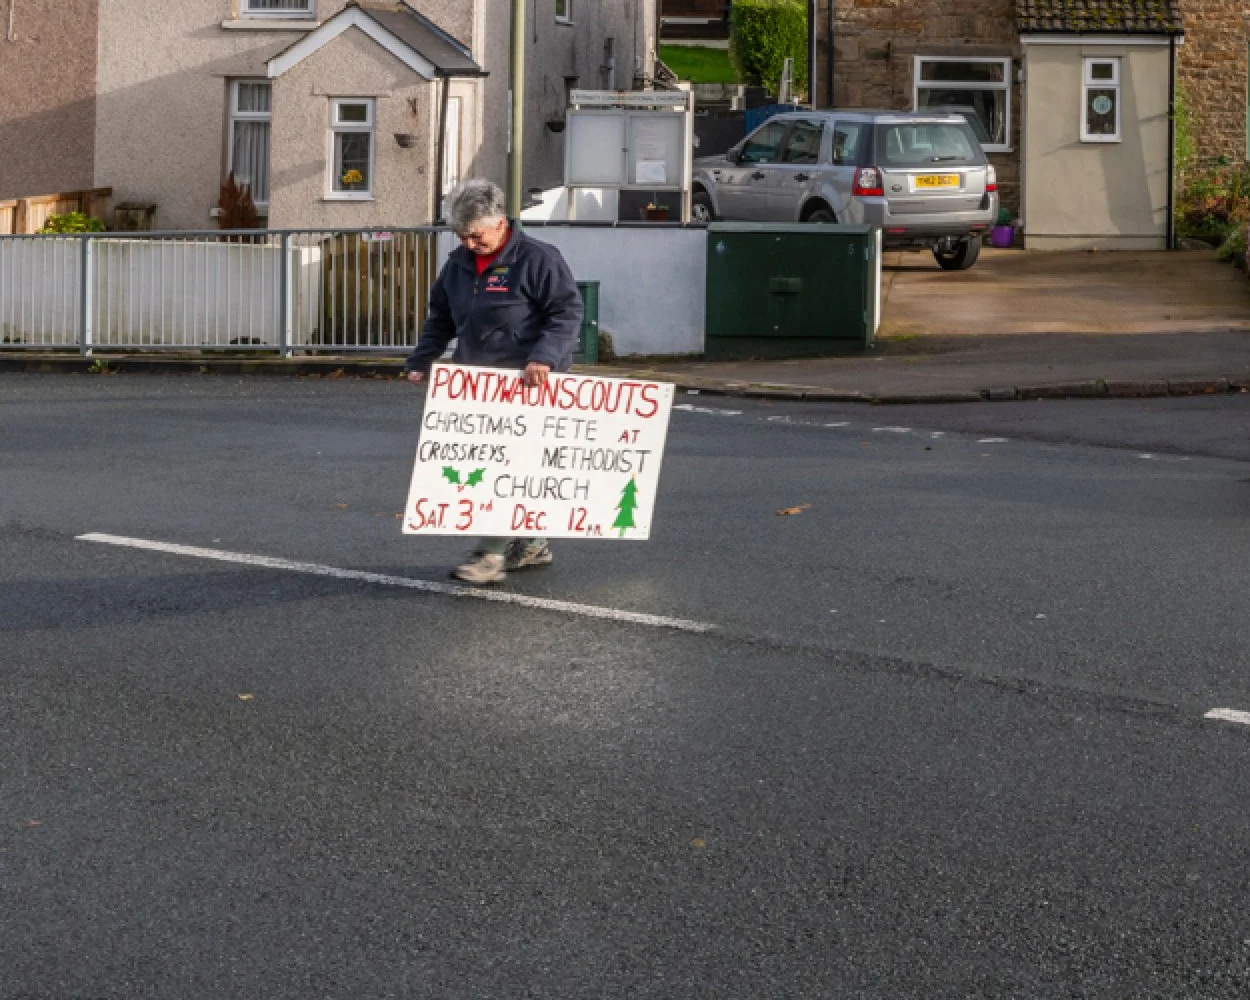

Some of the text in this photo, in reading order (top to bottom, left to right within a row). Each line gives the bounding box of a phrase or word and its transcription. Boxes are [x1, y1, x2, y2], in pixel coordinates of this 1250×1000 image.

[423, 410, 641, 444] CHRISTMAS FETE AT
[541, 447, 652, 474] METHODIST
[493, 474, 591, 501] CHURCH
